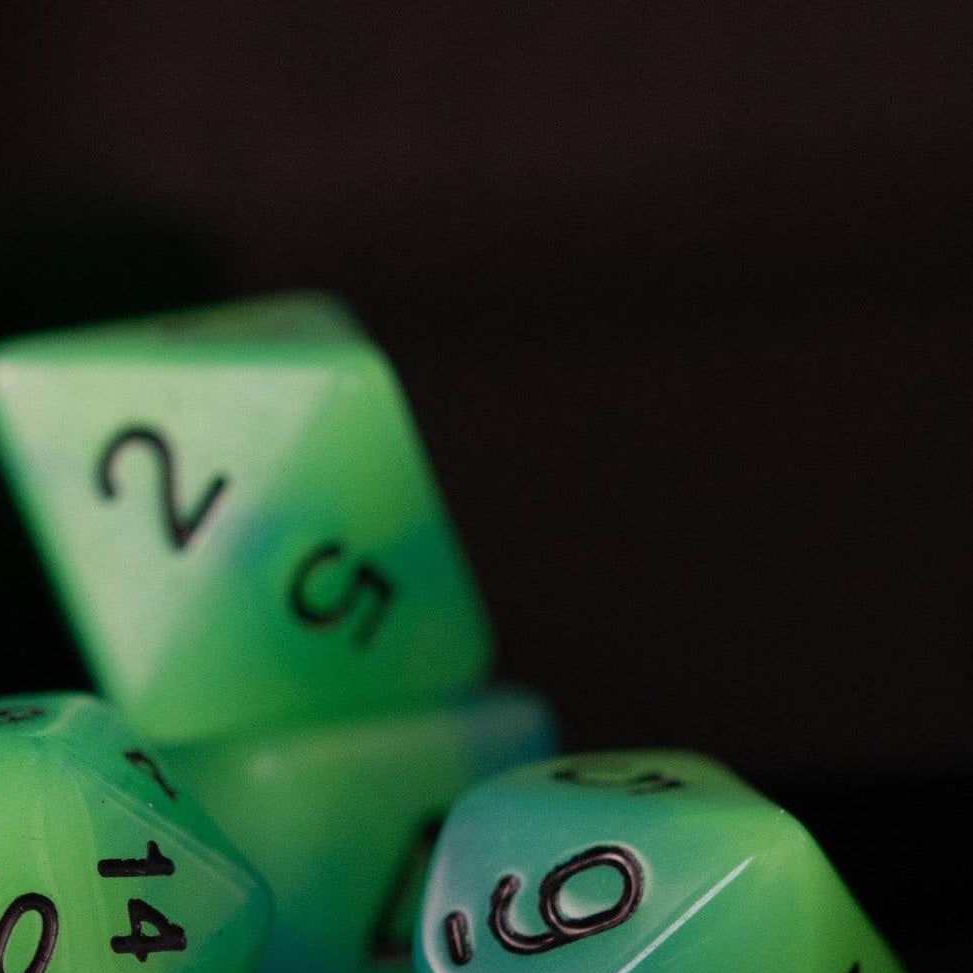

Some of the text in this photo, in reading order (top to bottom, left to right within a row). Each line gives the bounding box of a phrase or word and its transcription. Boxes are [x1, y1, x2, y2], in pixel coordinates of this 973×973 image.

[96, 424, 227, 556] 2
[289, 543, 396, 648] 5
[97, 839, 187, 962] 14
